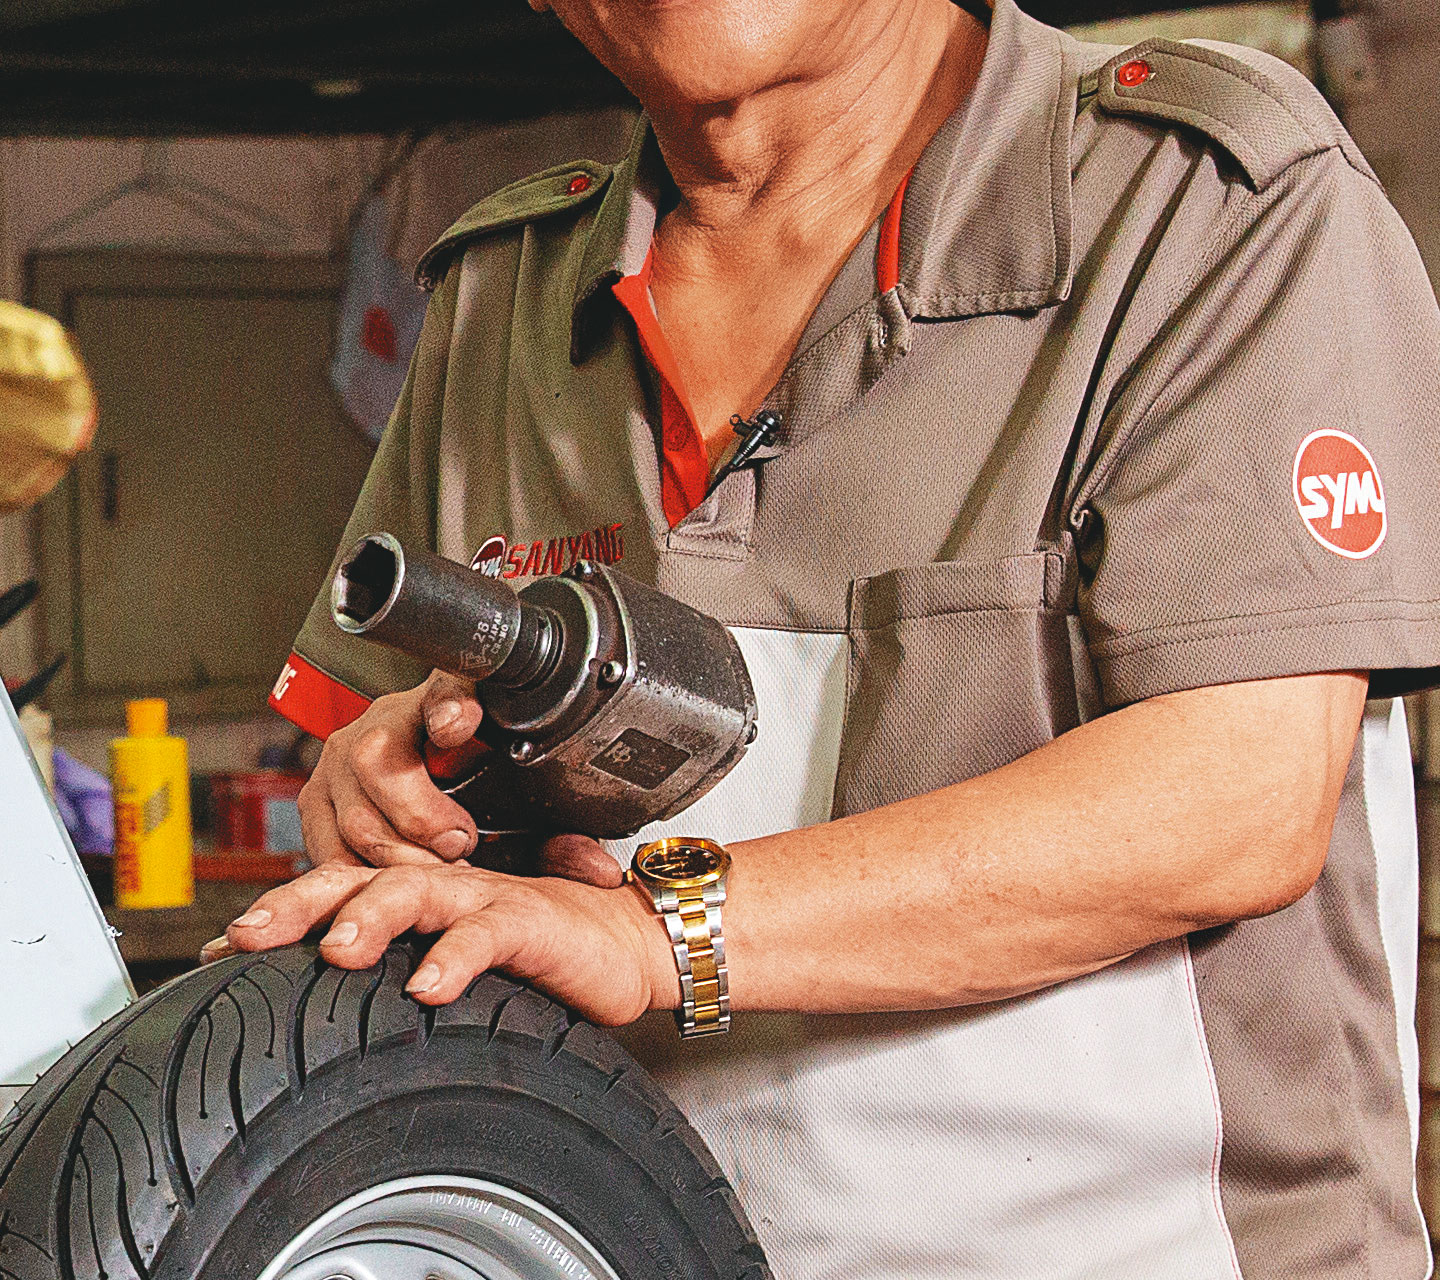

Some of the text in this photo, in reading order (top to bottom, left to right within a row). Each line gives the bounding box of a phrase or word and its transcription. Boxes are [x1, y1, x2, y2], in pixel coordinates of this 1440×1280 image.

[1300, 470, 1385, 530] SYM
[503, 523, 625, 579] SANYANG
[472, 621, 490, 643] 26
